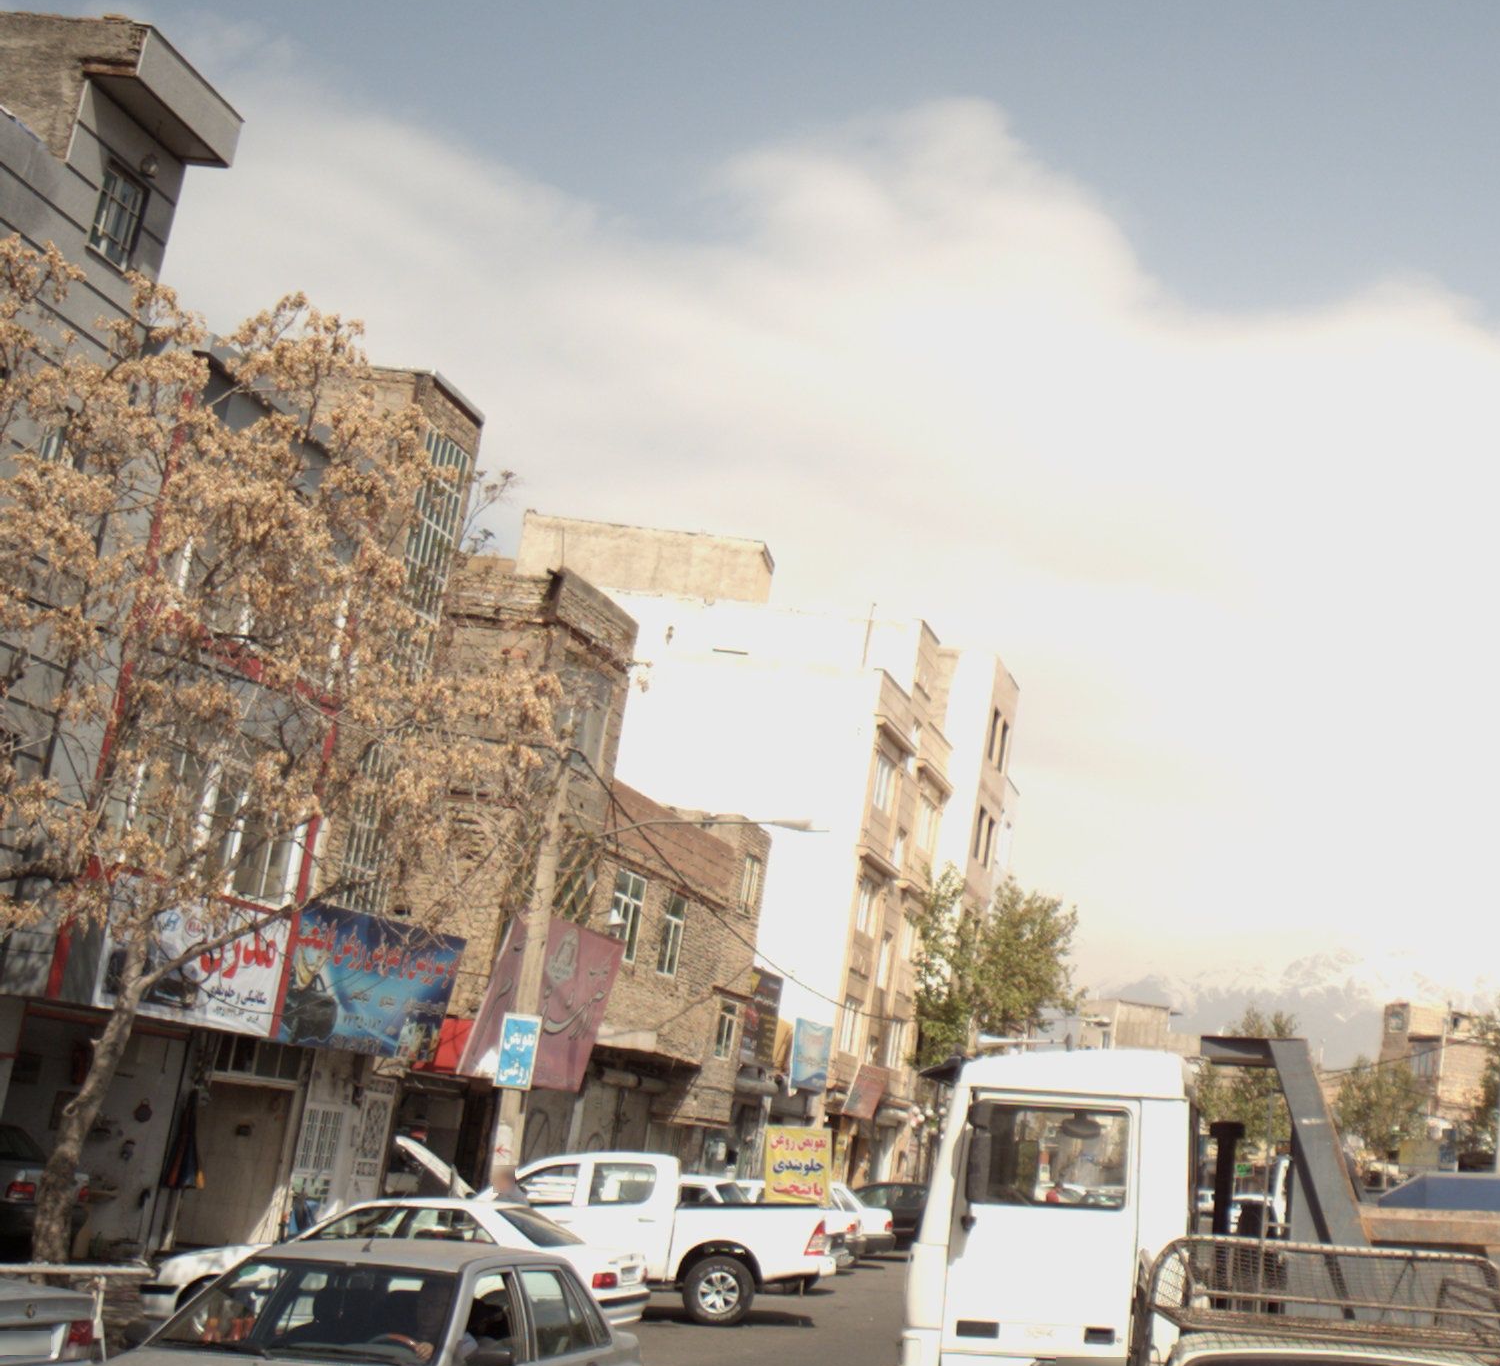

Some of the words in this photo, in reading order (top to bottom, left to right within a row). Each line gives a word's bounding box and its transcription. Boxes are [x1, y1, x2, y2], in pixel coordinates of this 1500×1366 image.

[504, 1026, 538, 1052] تعویض
[770, 1133, 796, 1151] روغن
[798, 1137, 827, 1152] تعویض
[773, 1158, 824, 1176] جلوبندی
